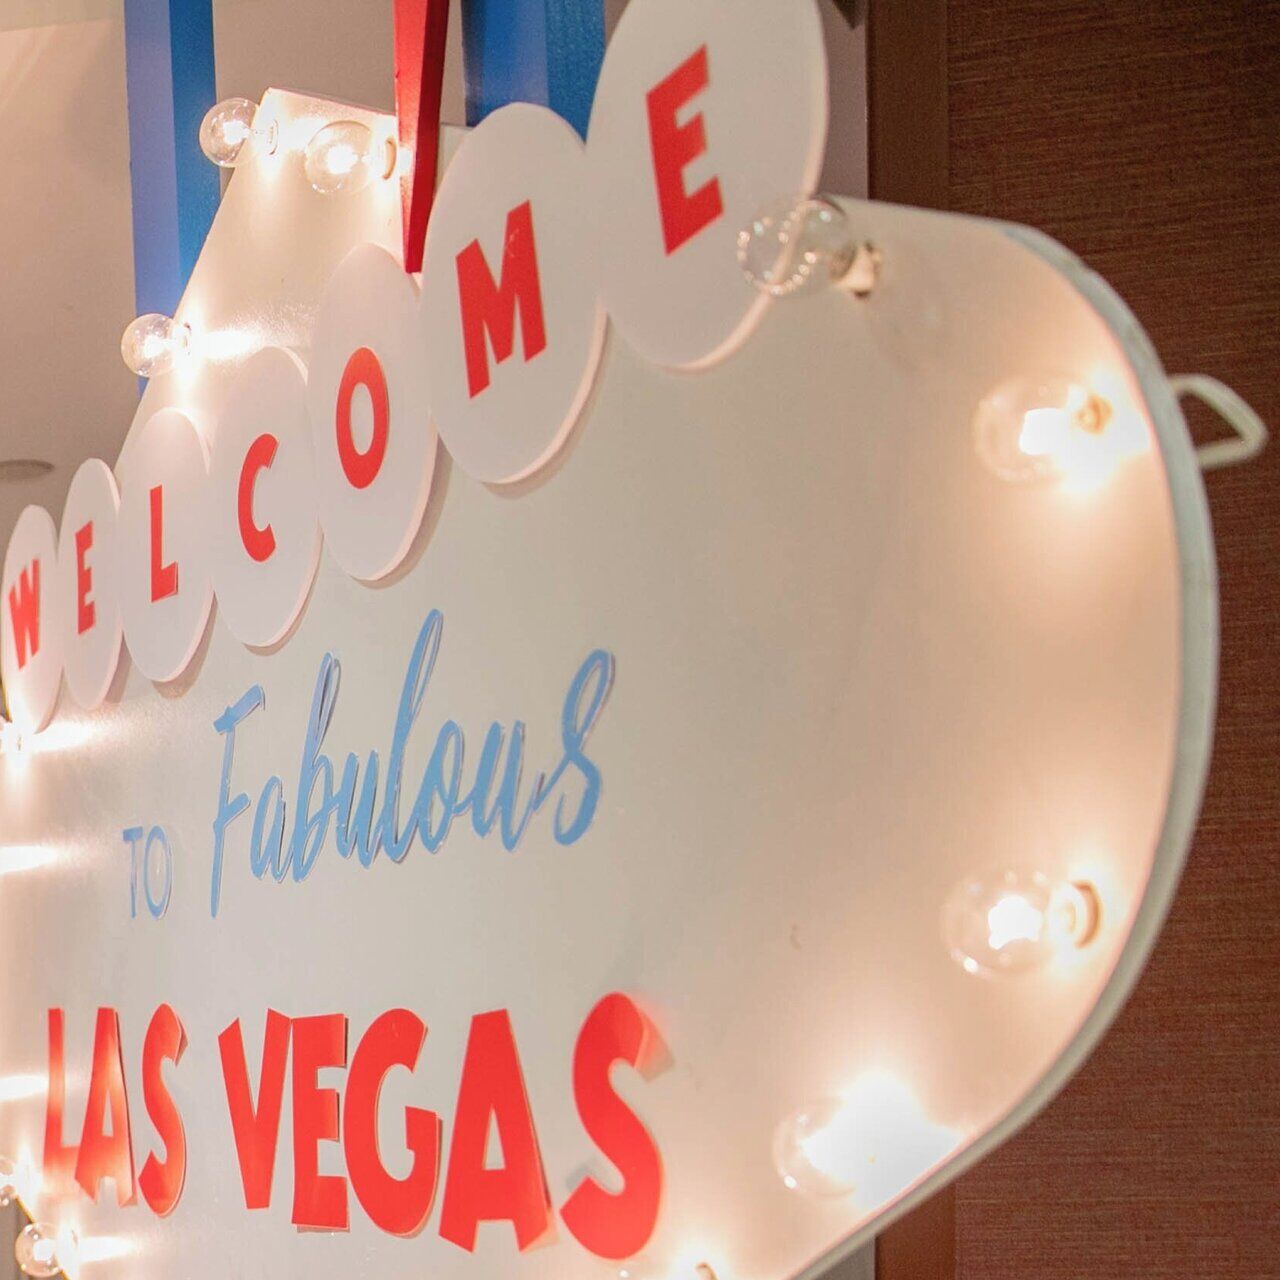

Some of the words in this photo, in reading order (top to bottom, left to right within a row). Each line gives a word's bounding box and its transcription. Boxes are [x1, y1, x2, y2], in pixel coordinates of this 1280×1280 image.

[7, 44, 724, 670] WELCOME
[122, 825, 174, 920] TO
[209, 608, 615, 919] Fabulous
[42, 1003, 188, 1217] LAS
[218, 992, 668, 1261] VEGAS
